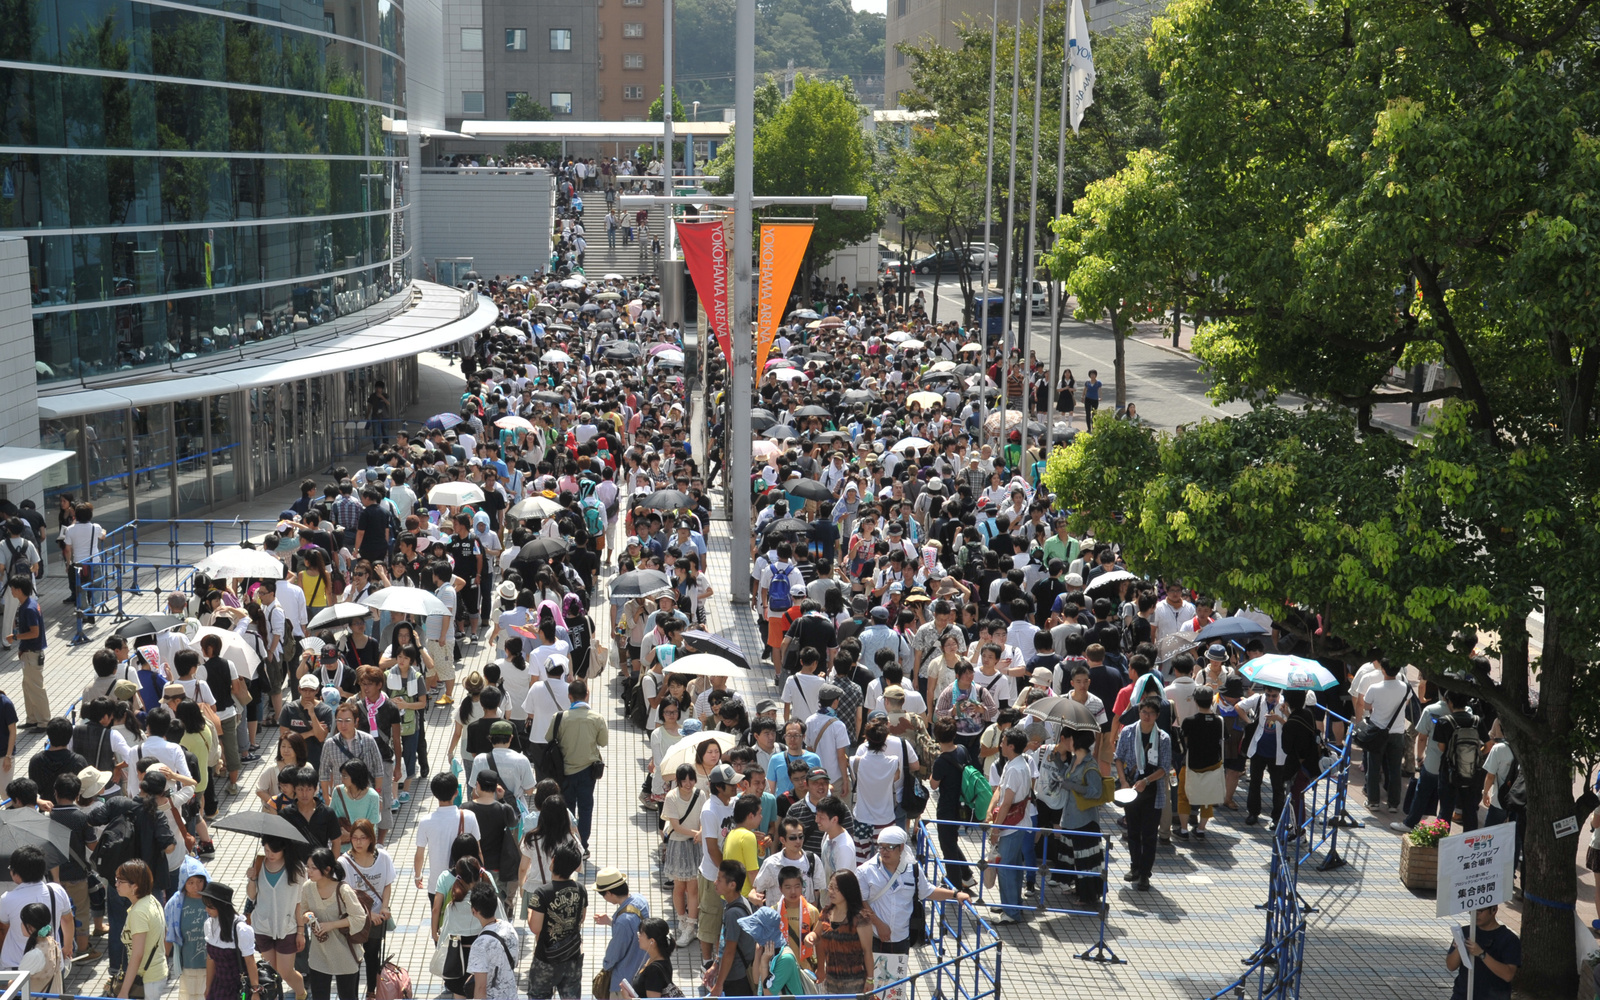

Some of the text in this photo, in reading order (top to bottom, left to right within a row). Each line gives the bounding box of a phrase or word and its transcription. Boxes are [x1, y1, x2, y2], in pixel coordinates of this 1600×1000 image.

[712, 225, 728, 338] YOKOHAMA ARENA
[759, 228, 775, 344] YOKOHAMA ARENA
[1457, 847, 1499, 863] ワークショップ
[1463, 856, 1493, 870] 集合場所
[1457, 881, 1496, 899] 集合時間
[1460, 894, 1493, 909] 10:00
